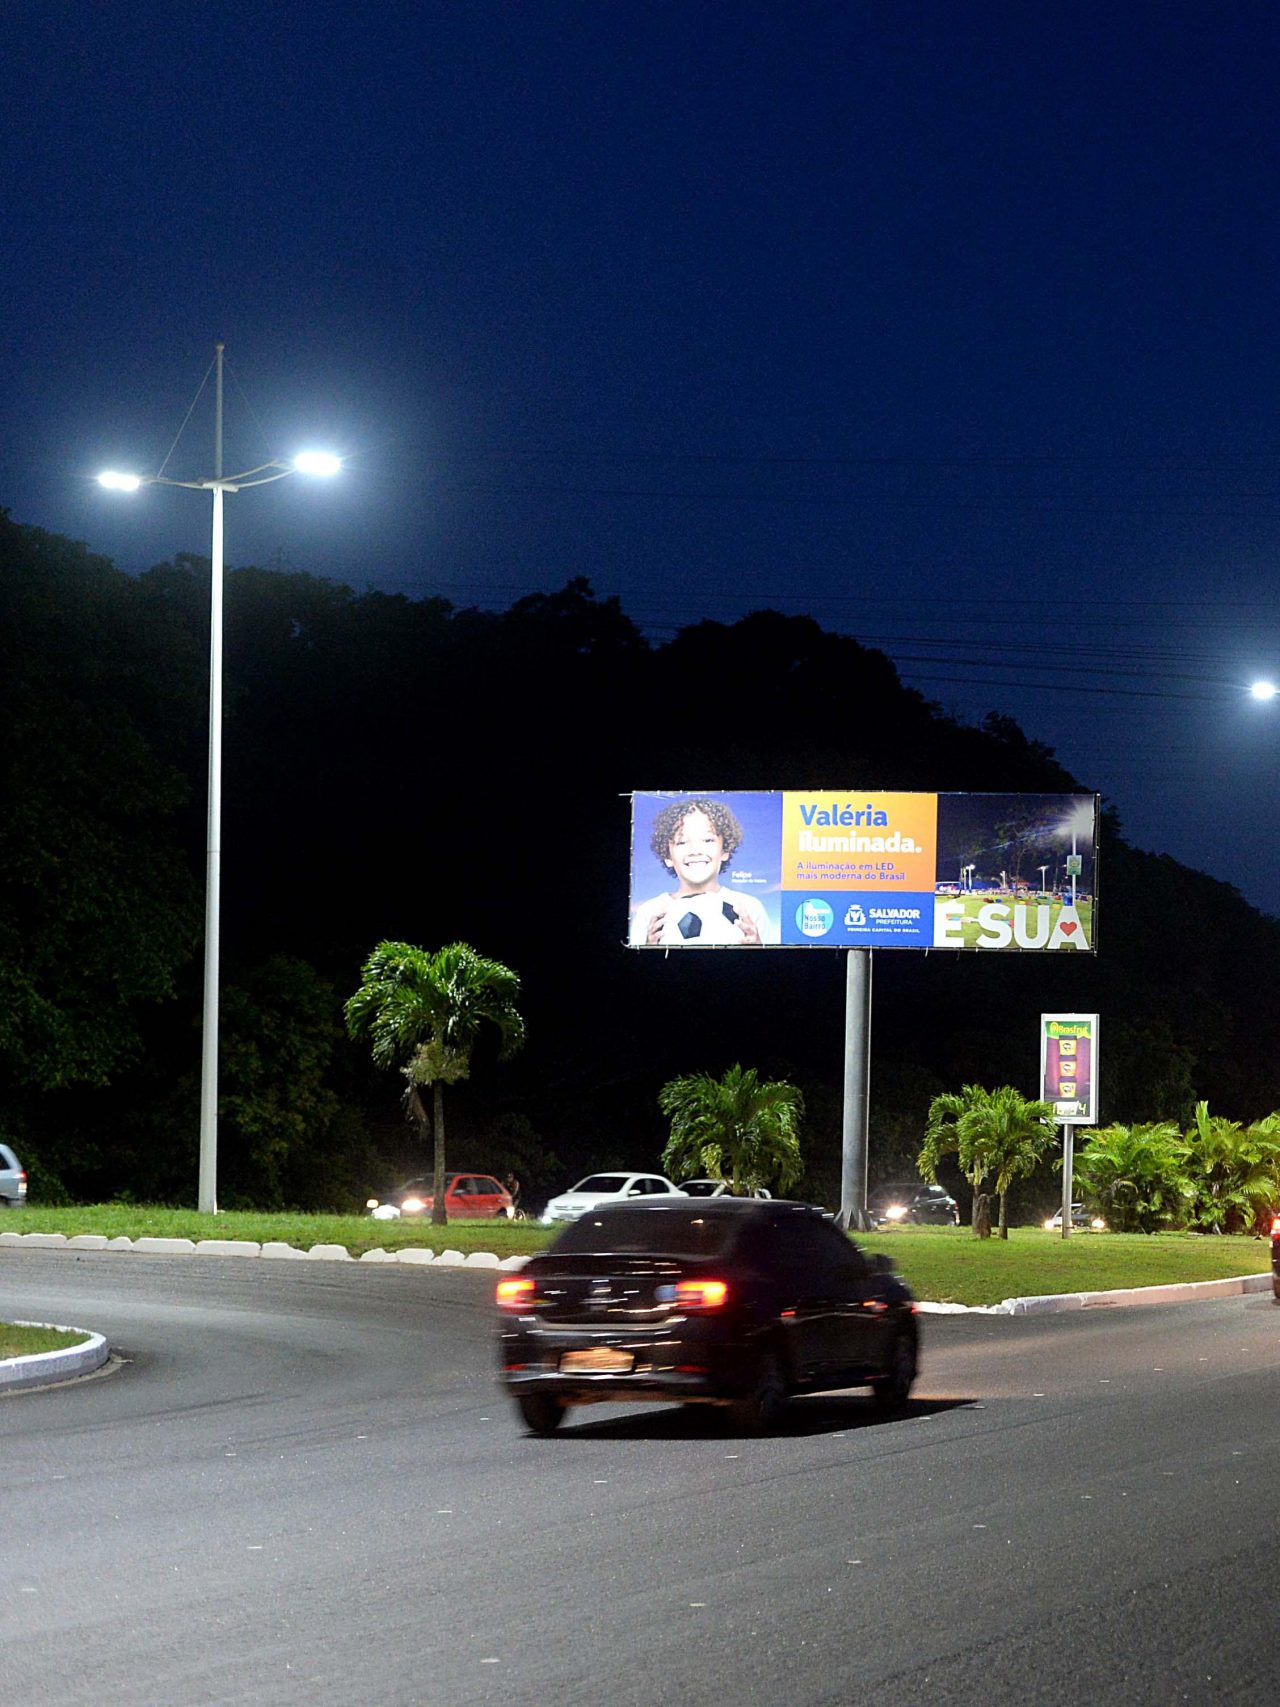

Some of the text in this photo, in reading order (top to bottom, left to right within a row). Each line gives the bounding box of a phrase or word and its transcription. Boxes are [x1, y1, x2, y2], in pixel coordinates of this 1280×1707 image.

[800, 803, 888, 827] Valéria
[799, 830, 922, 853] Iluminada.
[796, 862, 804, 870] A
[806, 862, 856, 872] iluminação
[875, 862, 894, 871] LED
[820, 872, 862, 880] moderna
[867, 872, 877, 880] do
[879, 872, 905, 881] Brasil
[868, 908, 920, 919] SALVADOR
[804, 922, 826, 930] Bairro
[875, 918, 913, 926] PREFEITURA
[976, 903, 1090, 950] SUA
